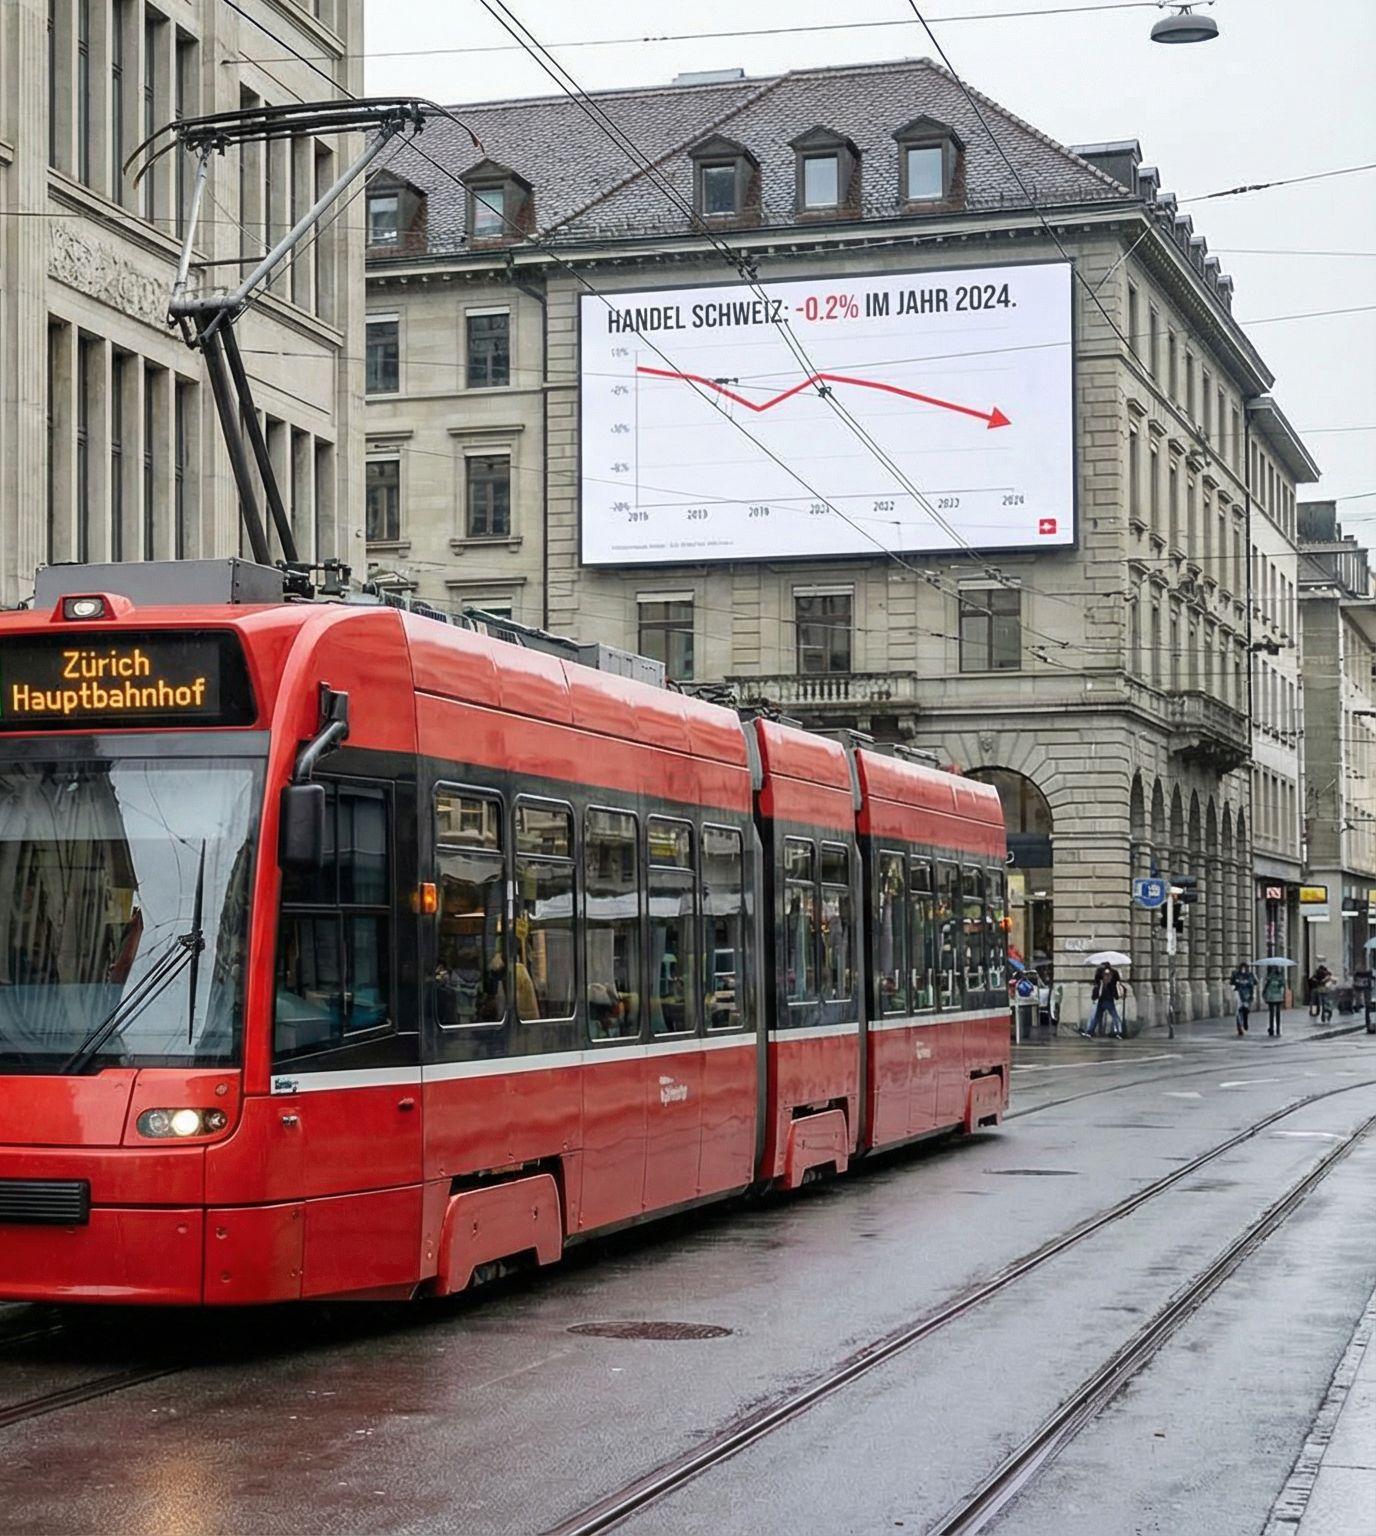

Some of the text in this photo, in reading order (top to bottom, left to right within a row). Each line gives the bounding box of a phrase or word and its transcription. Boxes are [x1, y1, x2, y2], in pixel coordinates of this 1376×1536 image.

[608, 283, 1017, 334] HANDEL SCHWEIZ: -0.2% IM JAHR 2024.
[63, 649, 150, 679] Zürich
[13, 677, 206, 714] Hauptbahnhof
